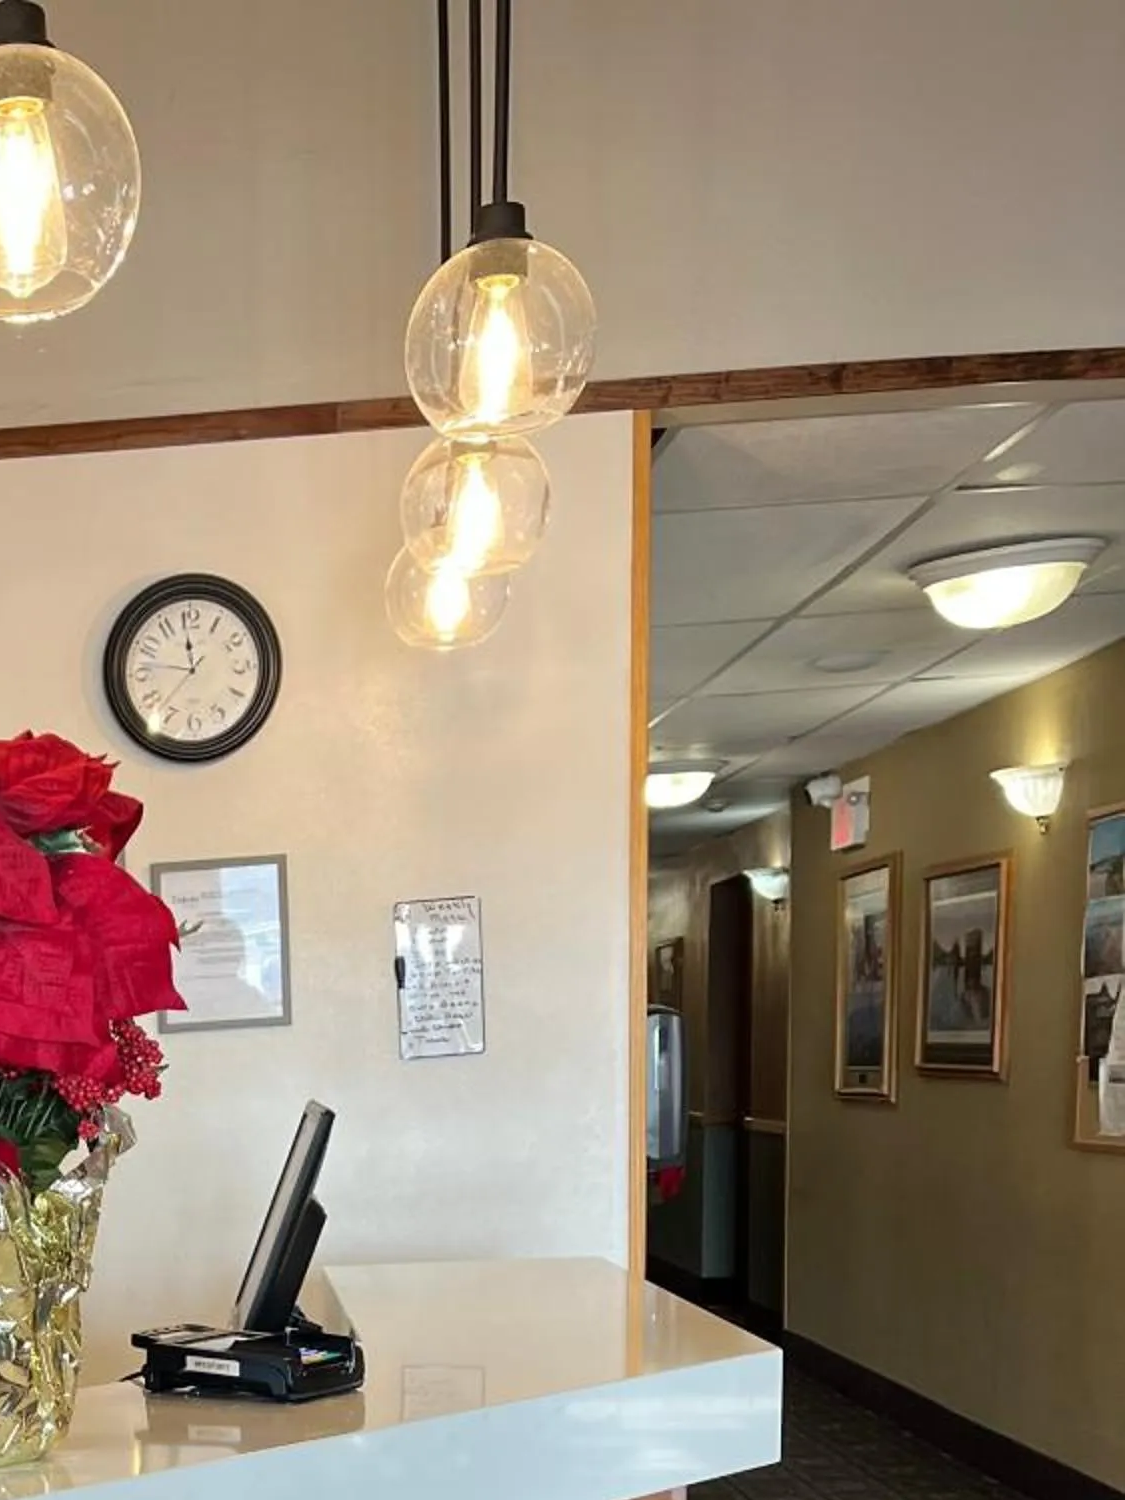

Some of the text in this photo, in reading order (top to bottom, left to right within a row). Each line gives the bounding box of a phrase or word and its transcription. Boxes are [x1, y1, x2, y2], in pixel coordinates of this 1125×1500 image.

[158, 616, 175, 639] 11
[181, 608, 200, 630] 12
[210, 615, 222, 634] 1
[139, 635, 160, 659] 10
[225, 631, 243, 652] 2
[163, 705, 179, 724] 7
[186, 713, 202, 732] 6
